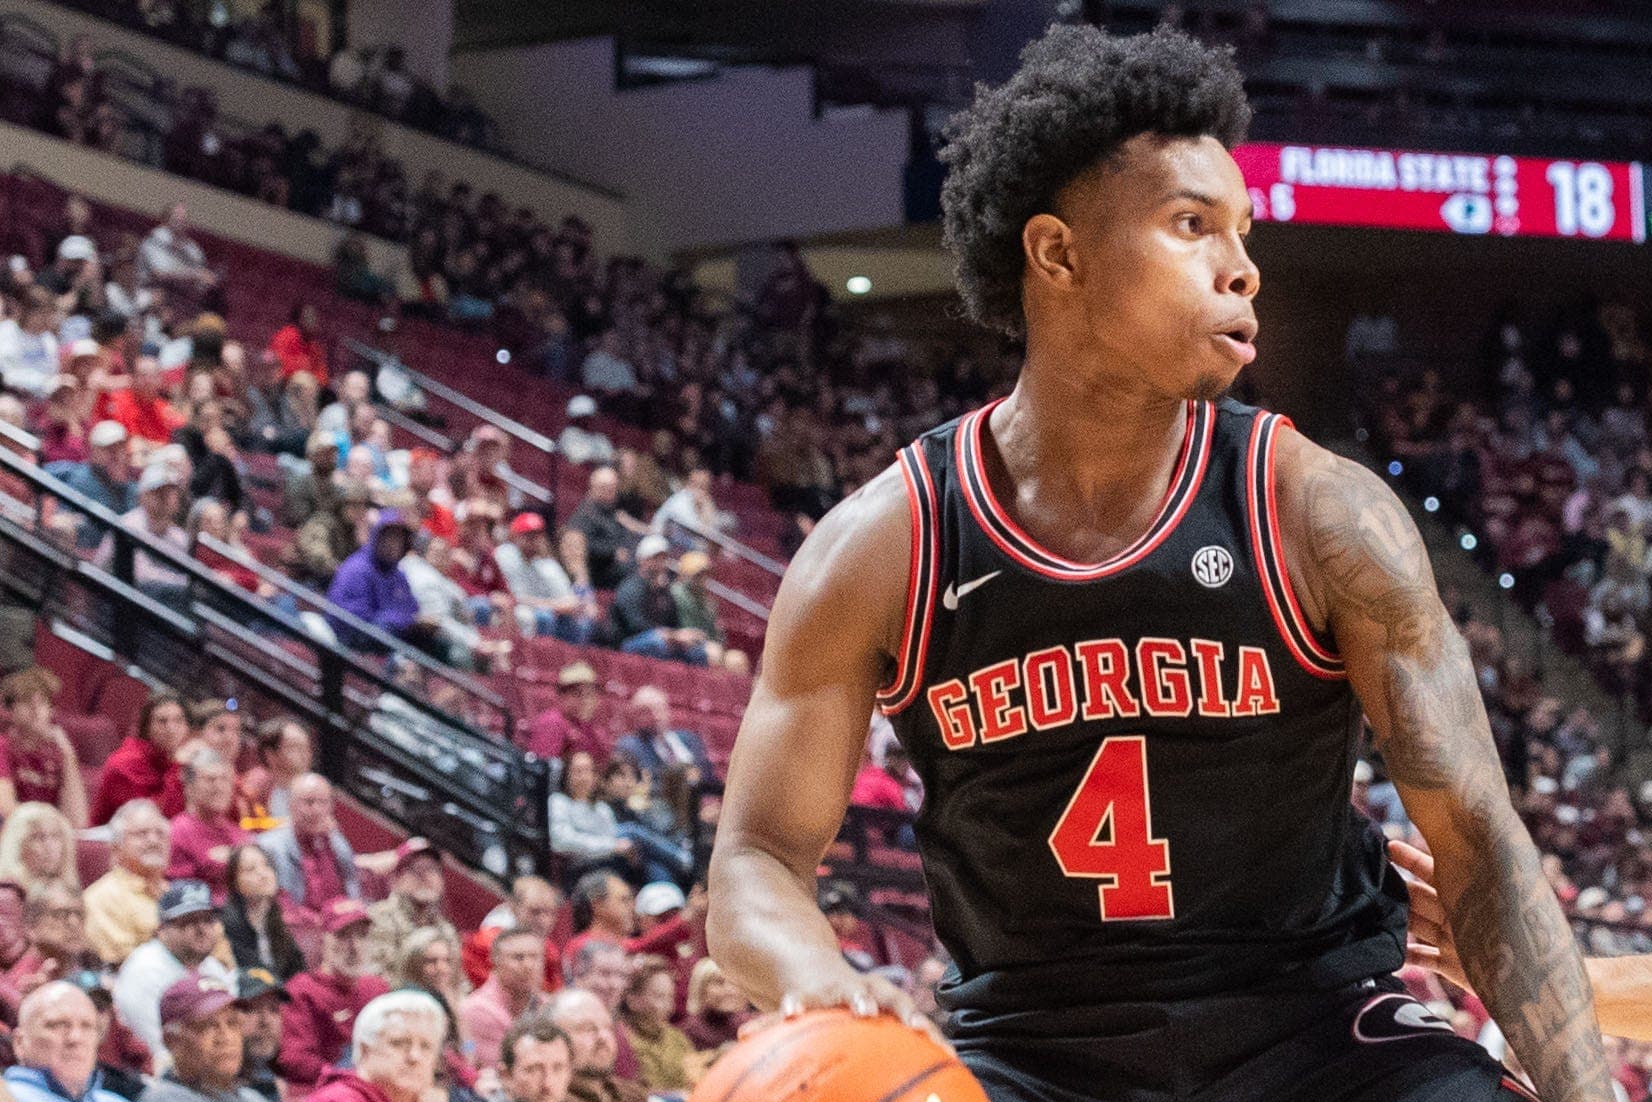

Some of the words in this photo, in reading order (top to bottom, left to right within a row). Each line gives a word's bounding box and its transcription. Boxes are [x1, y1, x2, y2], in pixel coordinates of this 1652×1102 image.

[1281, 146, 1398, 191] FLORIDA
[1400, 153, 1491, 194] STATE
[1546, 161, 1616, 238] 18
[1194, 547, 1232, 586] SEC
[928, 637, 1280, 751] GEORGIA
[1048, 735, 1175, 923] 4
